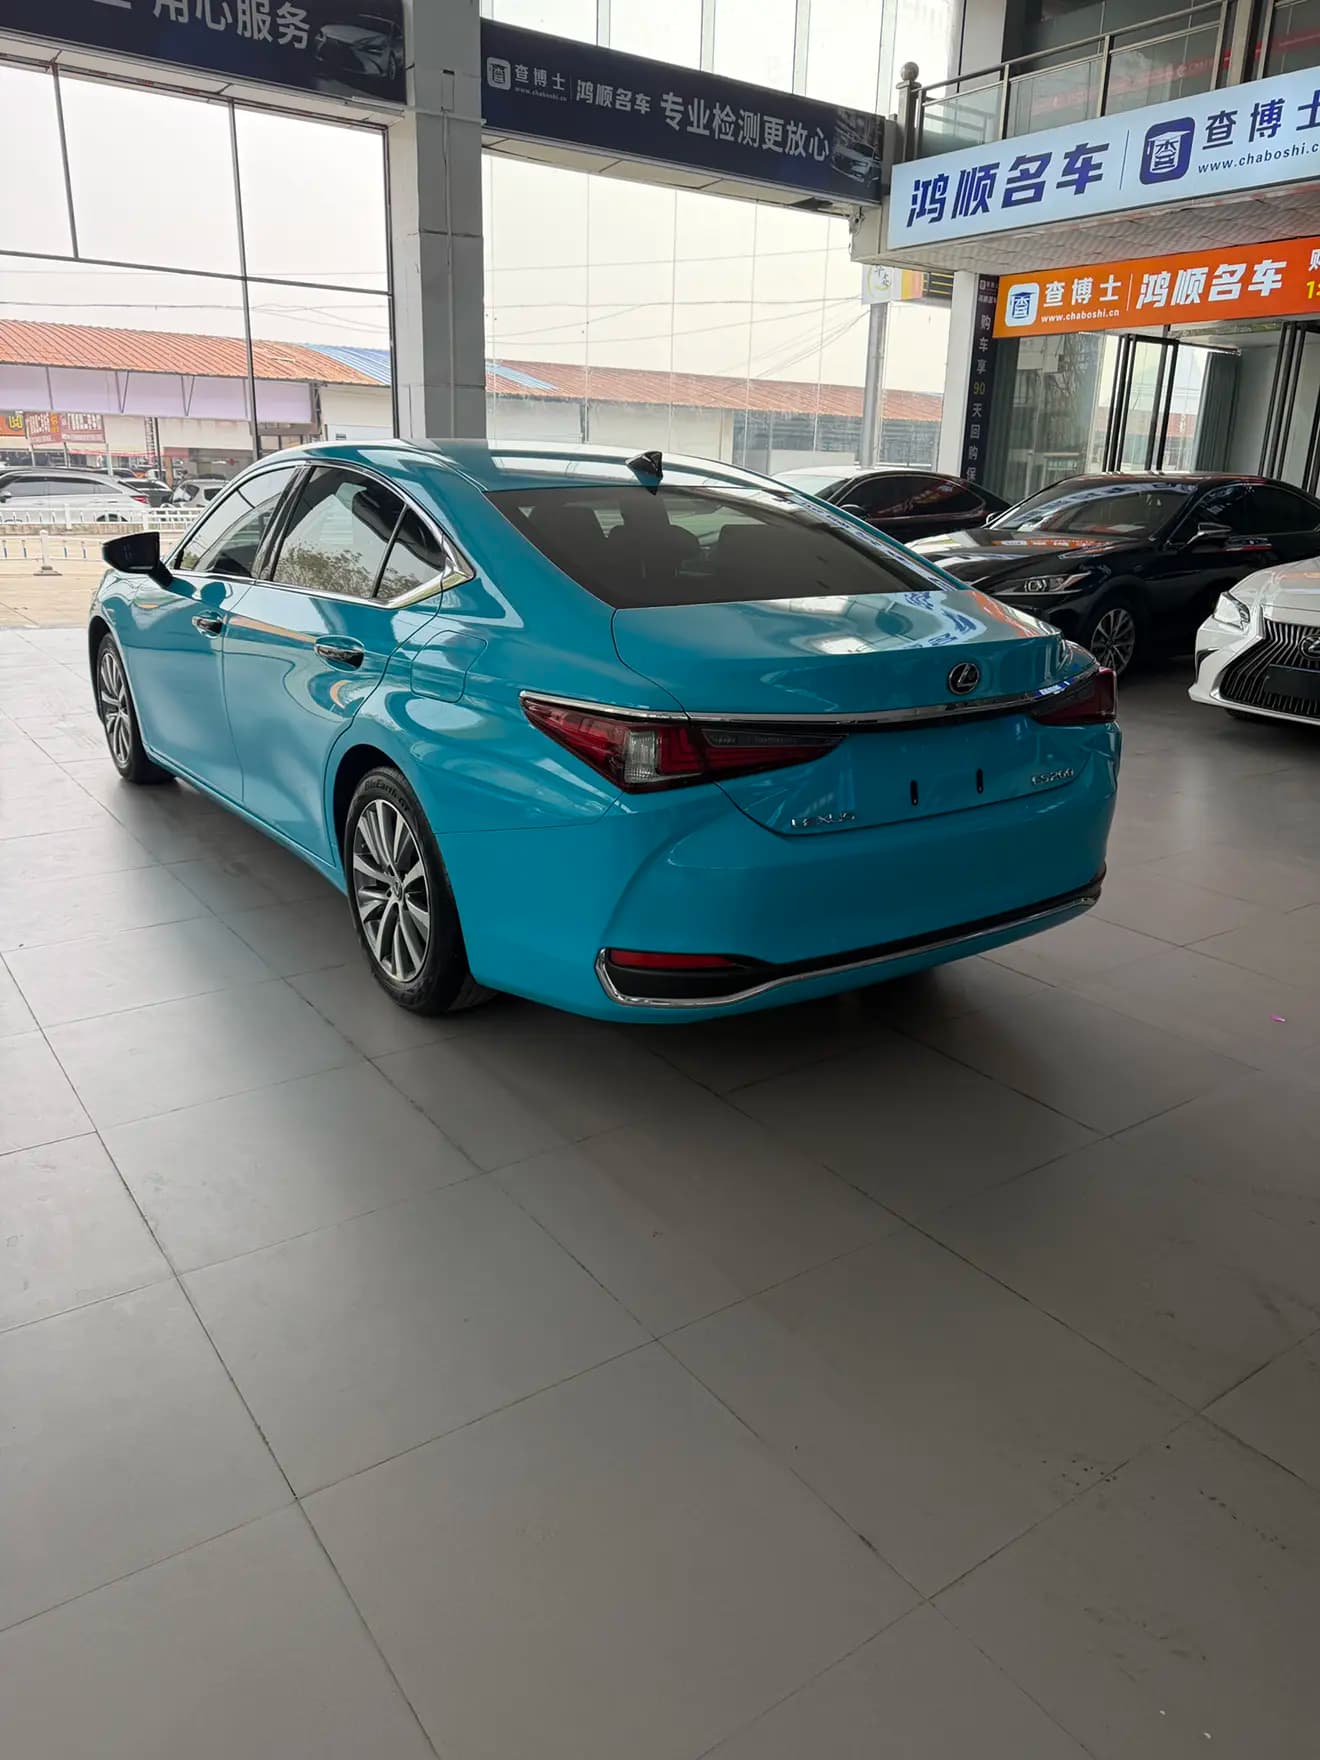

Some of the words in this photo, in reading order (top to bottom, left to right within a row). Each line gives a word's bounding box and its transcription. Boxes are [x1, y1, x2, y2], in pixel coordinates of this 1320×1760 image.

[515, 64, 566, 91] 查博士
[576, 79, 651, 114] 鸿顺名车
[660, 92, 830, 162] 专业检测更放心
[907, 142, 1110, 227] 鸿顺名车
[1043, 274, 1122, 307] 查博士
[1136, 259, 1287, 310] 鸿顺名车
[1041, 308, 1120, 323] www.chaboshi.cn
